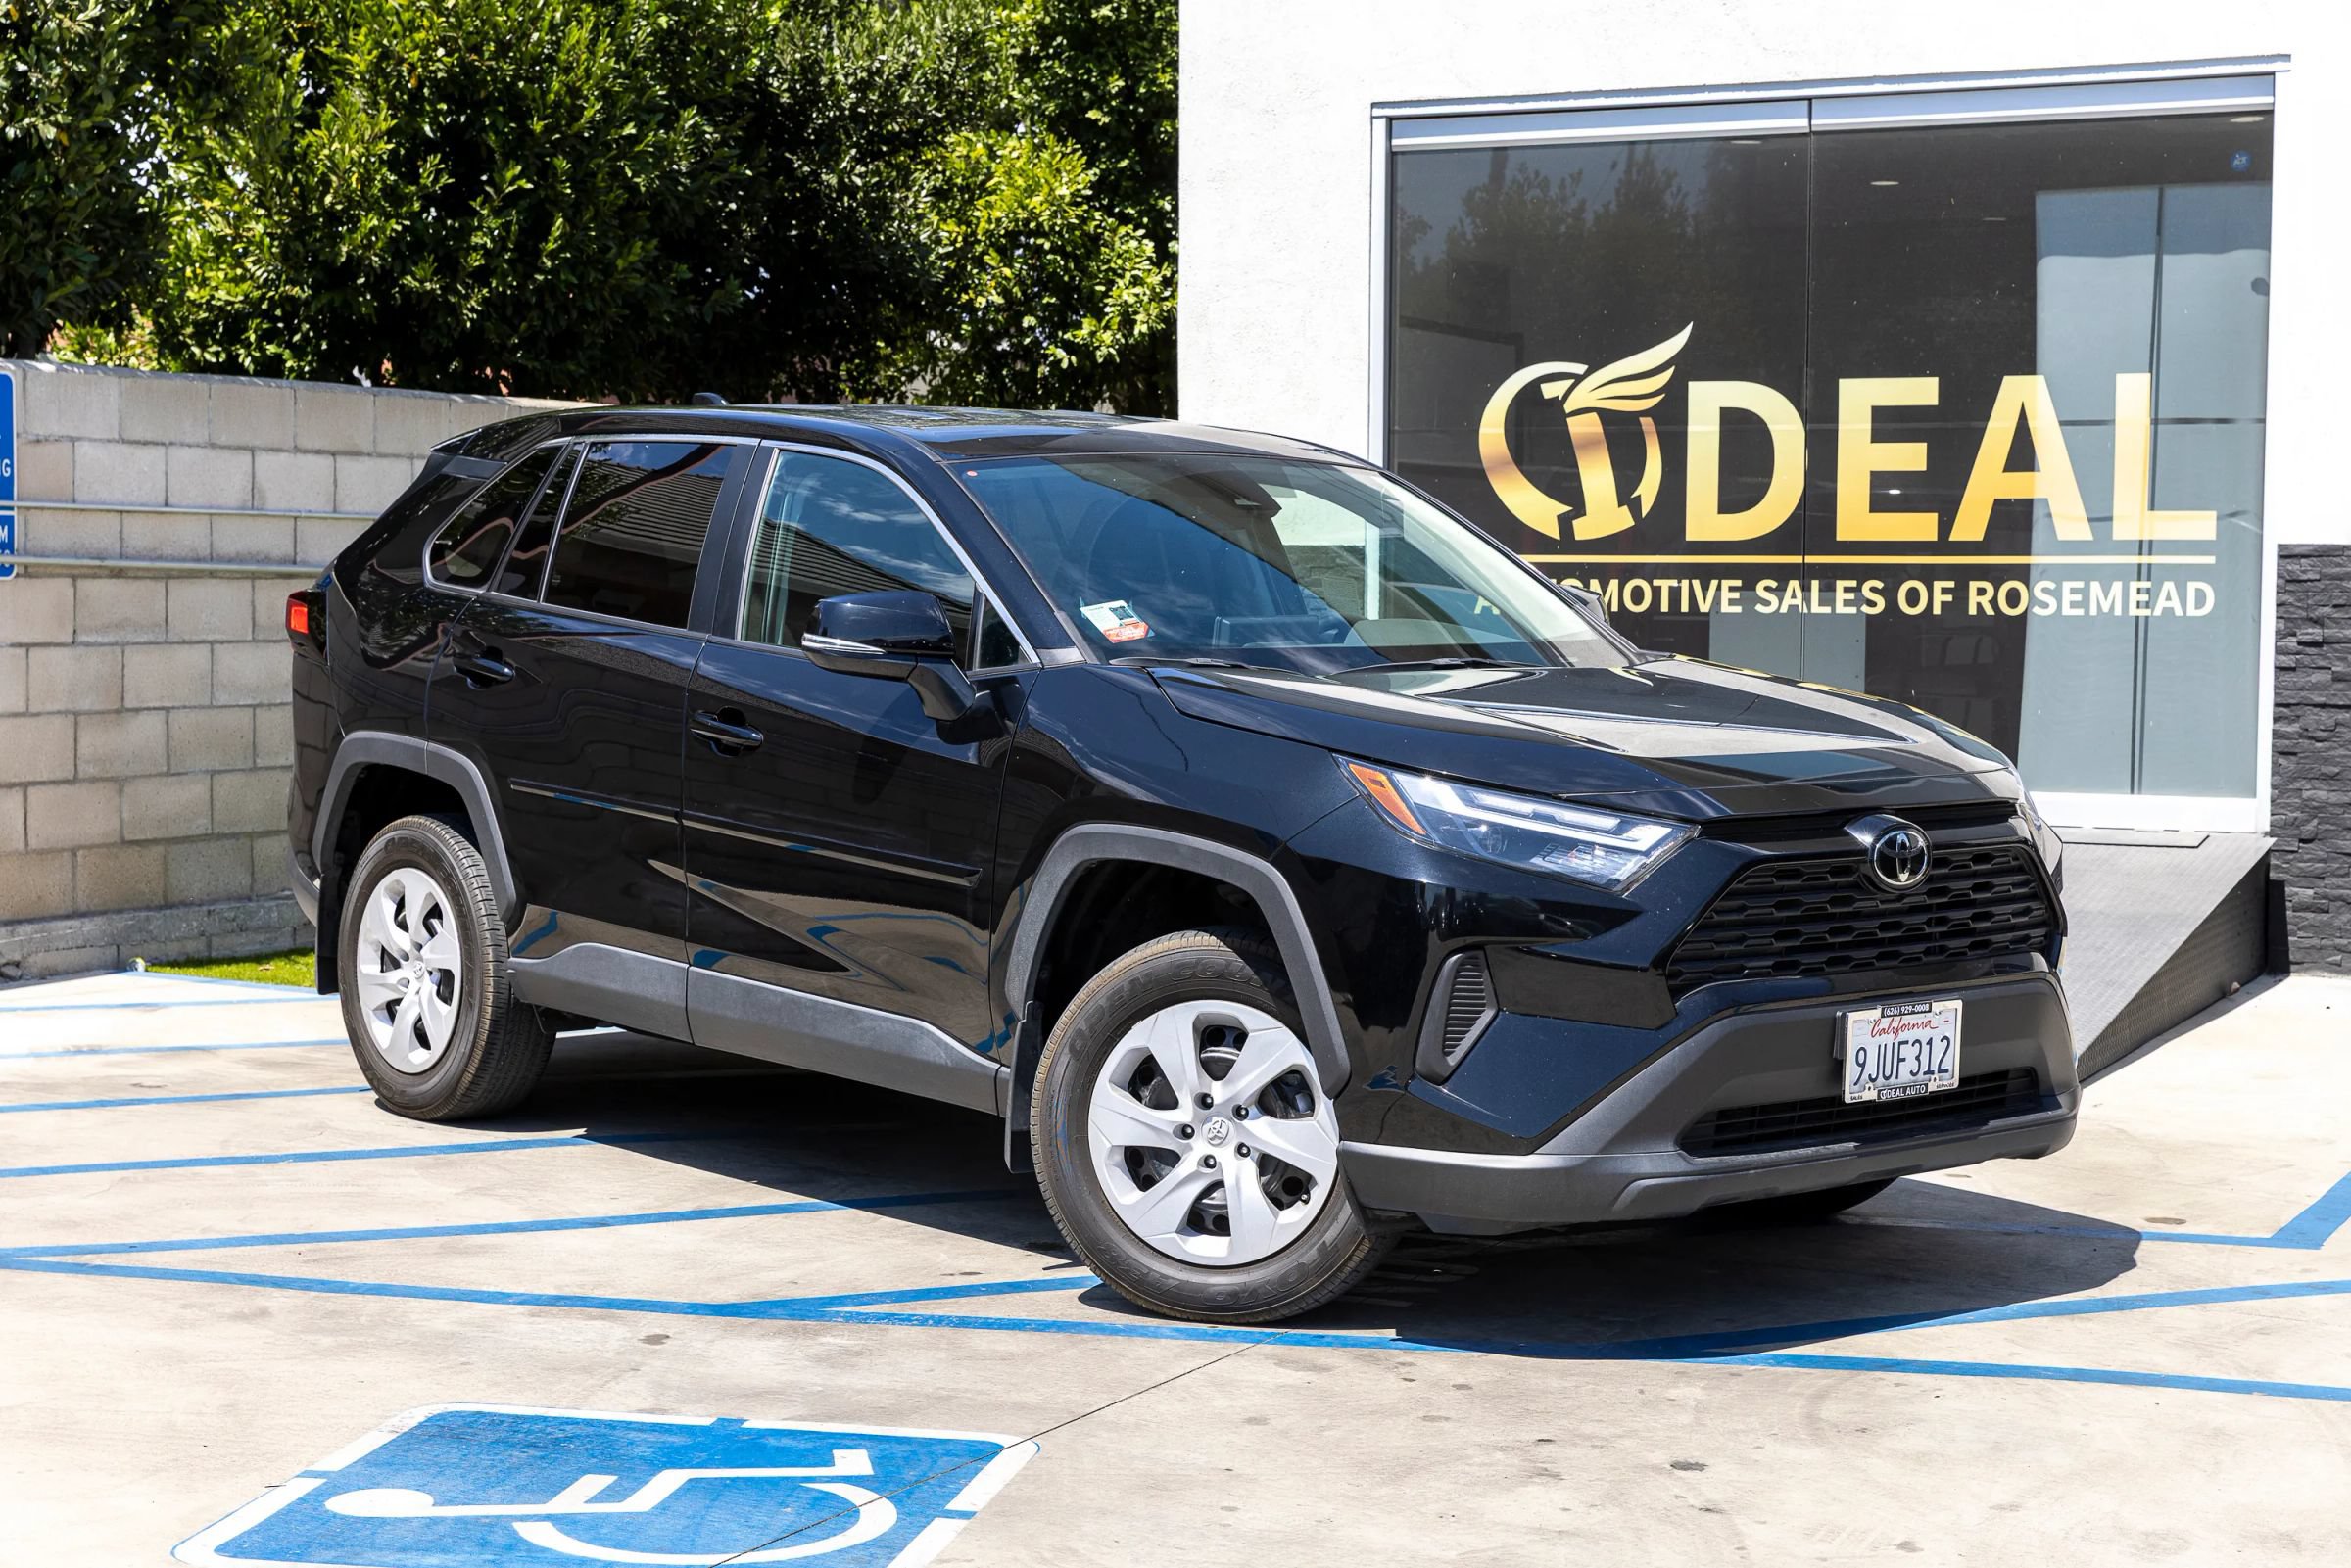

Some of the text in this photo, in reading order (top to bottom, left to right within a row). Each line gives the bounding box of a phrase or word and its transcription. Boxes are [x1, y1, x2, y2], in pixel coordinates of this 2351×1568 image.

[1754, 579, 1886, 615] SALES
[1897, 580, 1955, 615] OF
[1968, 580, 2215, 616] ROSEMEAD
[1871, 1018, 1939, 1040] California
[1853, 1035, 1950, 1087] 9JUF312
[1906, 1084, 1926, 1096] AUTO
